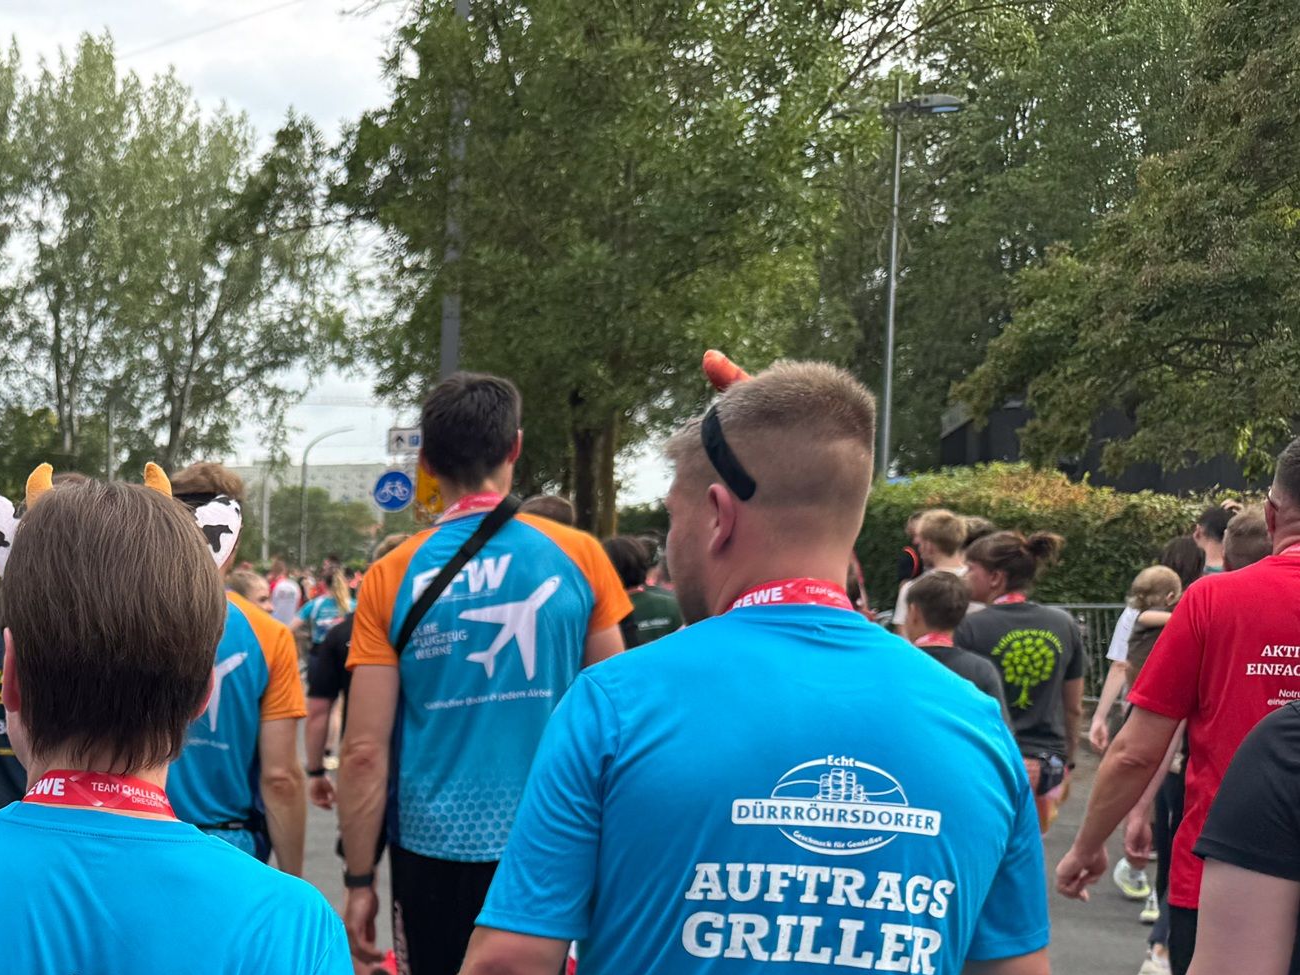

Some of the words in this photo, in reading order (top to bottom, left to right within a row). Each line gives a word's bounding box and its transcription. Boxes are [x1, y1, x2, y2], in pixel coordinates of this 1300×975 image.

[733, 586, 784, 608] REWE
[805, 586, 828, 595] TEAM
[827, 755, 856, 768] Echt
[26, 777, 66, 796] EWE
[91, 782, 120, 794] TEAM
[737, 801, 935, 831] DÜRRRÖHRSDORFER
[833, 840, 845, 848] für
[684, 862, 956, 920] AUFTRAGS
